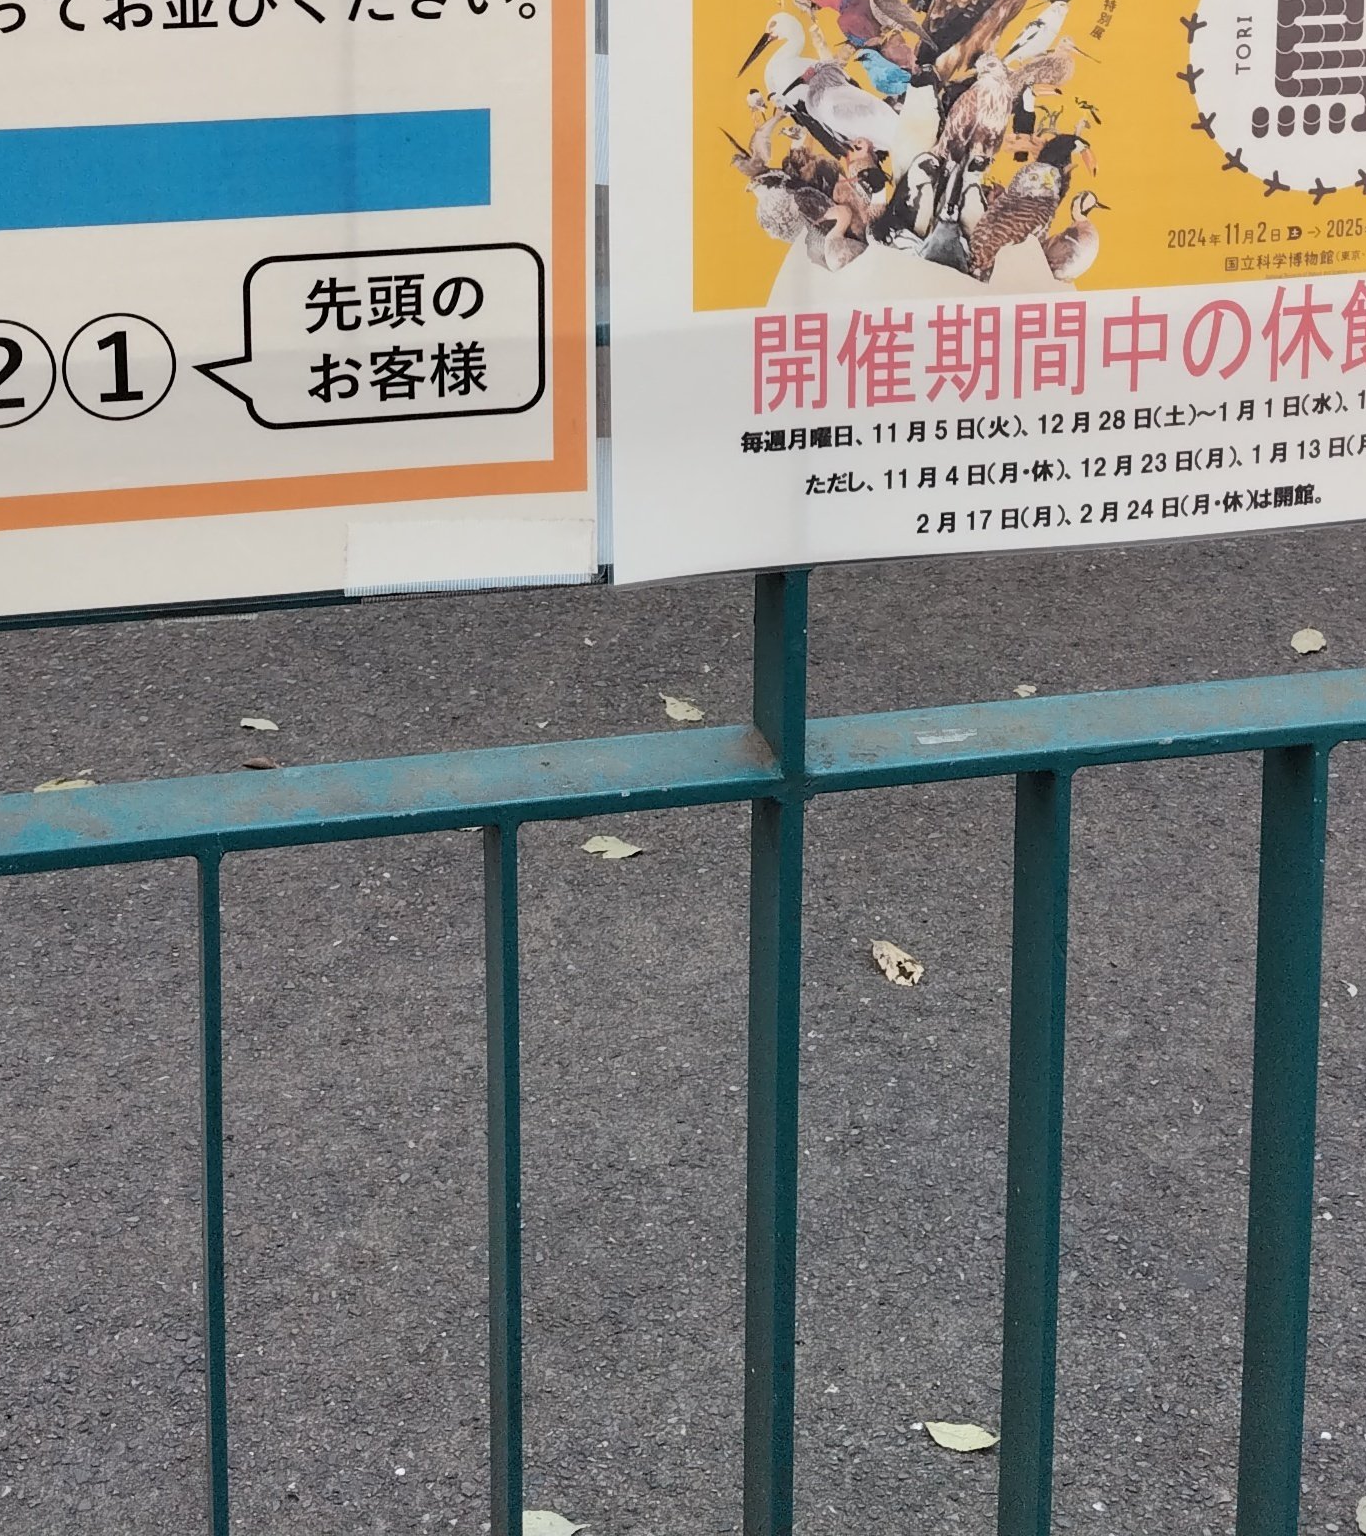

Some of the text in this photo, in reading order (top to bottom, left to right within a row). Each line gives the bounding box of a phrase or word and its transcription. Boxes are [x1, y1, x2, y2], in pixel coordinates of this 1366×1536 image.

[1235, 15, 1253, 75] TORI
[303, 271, 486, 332] 先頭の
[306, 339, 490, 404] お客様
